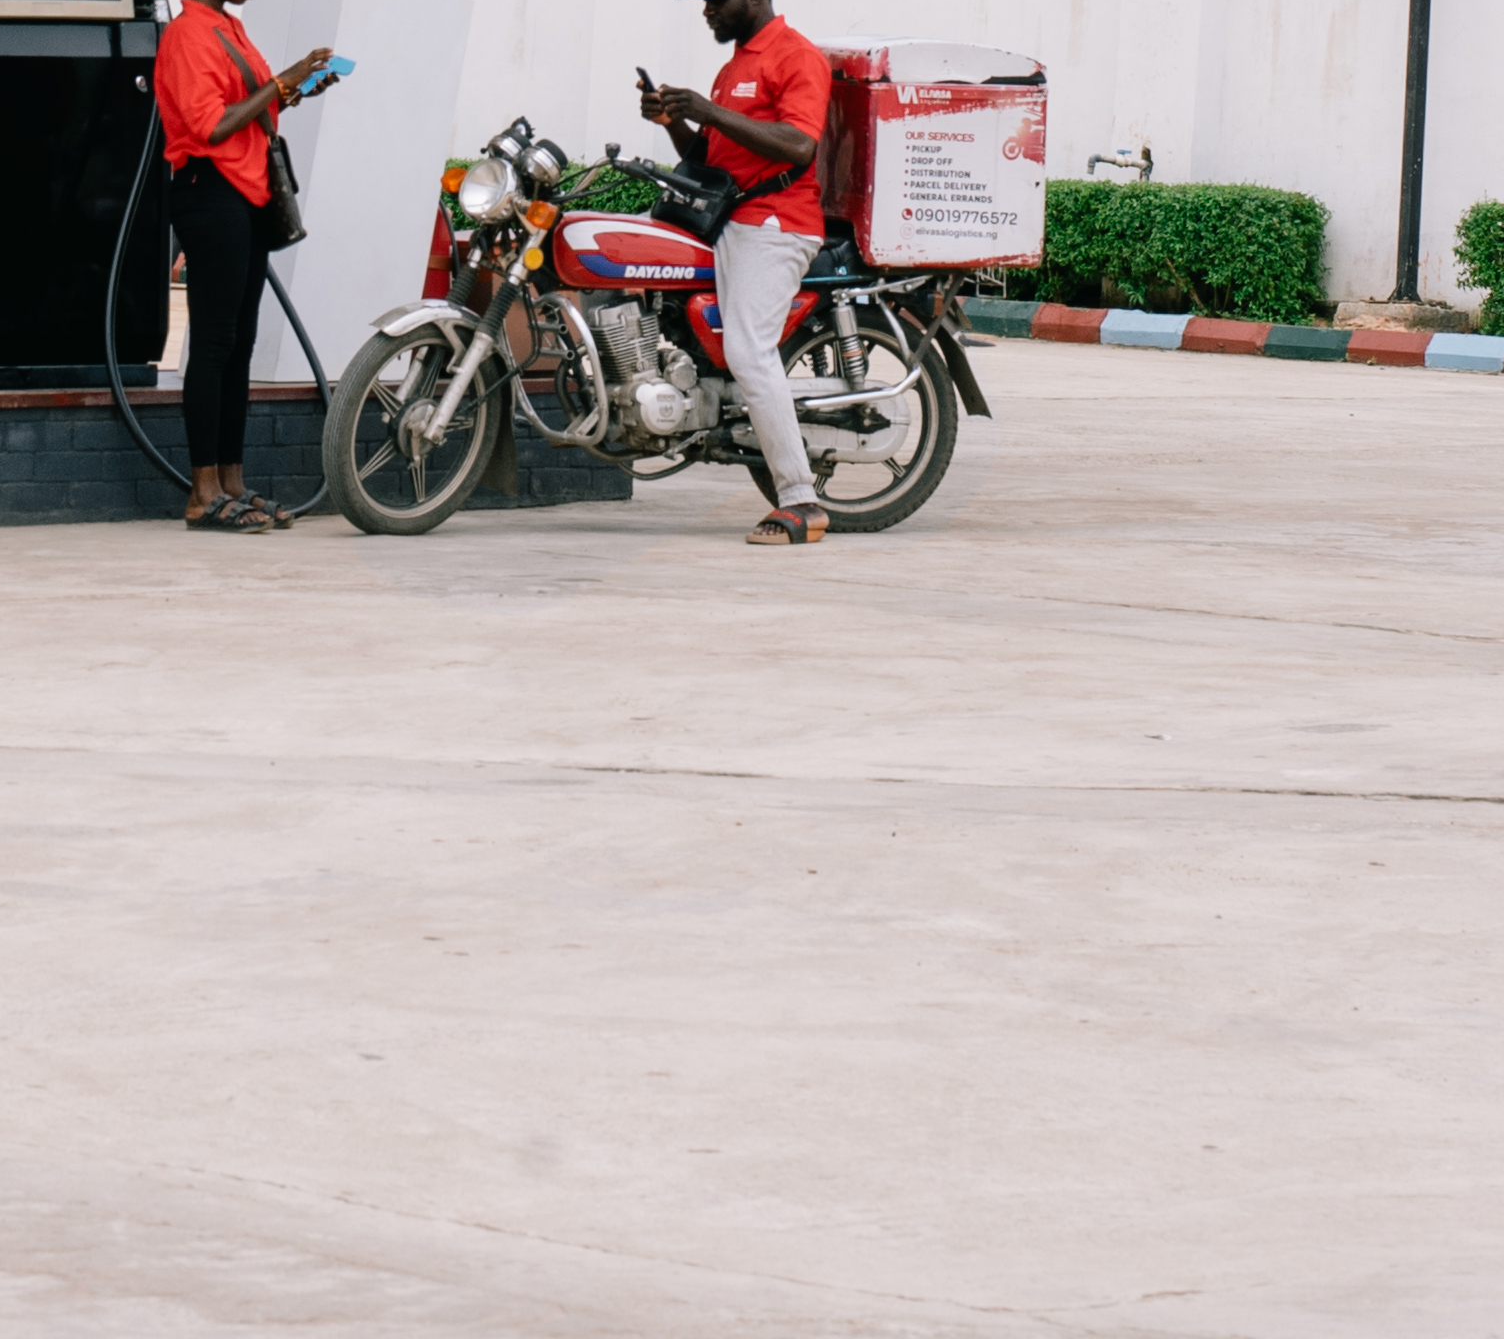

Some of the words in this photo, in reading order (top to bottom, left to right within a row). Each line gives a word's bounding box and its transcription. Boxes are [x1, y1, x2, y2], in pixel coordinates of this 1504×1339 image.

[905, 131, 925, 141] OUR
[928, 132, 974, 143] SERVICES
[912, 145, 942, 153] PICKUP
[911, 157, 934, 165] DROP
[936, 158, 953, 166] OFF
[910, 169, 971, 178] DISTRIBUTION
[910, 181, 941, 190] PARCEL
[944, 182, 987, 191] DELIVERY
[909, 192, 948, 202] GENERAL
[950, 194, 993, 203] ERRANDS
[915, 208, 1018, 225] 09019776572
[624, 265, 696, 279] DAYLONG
